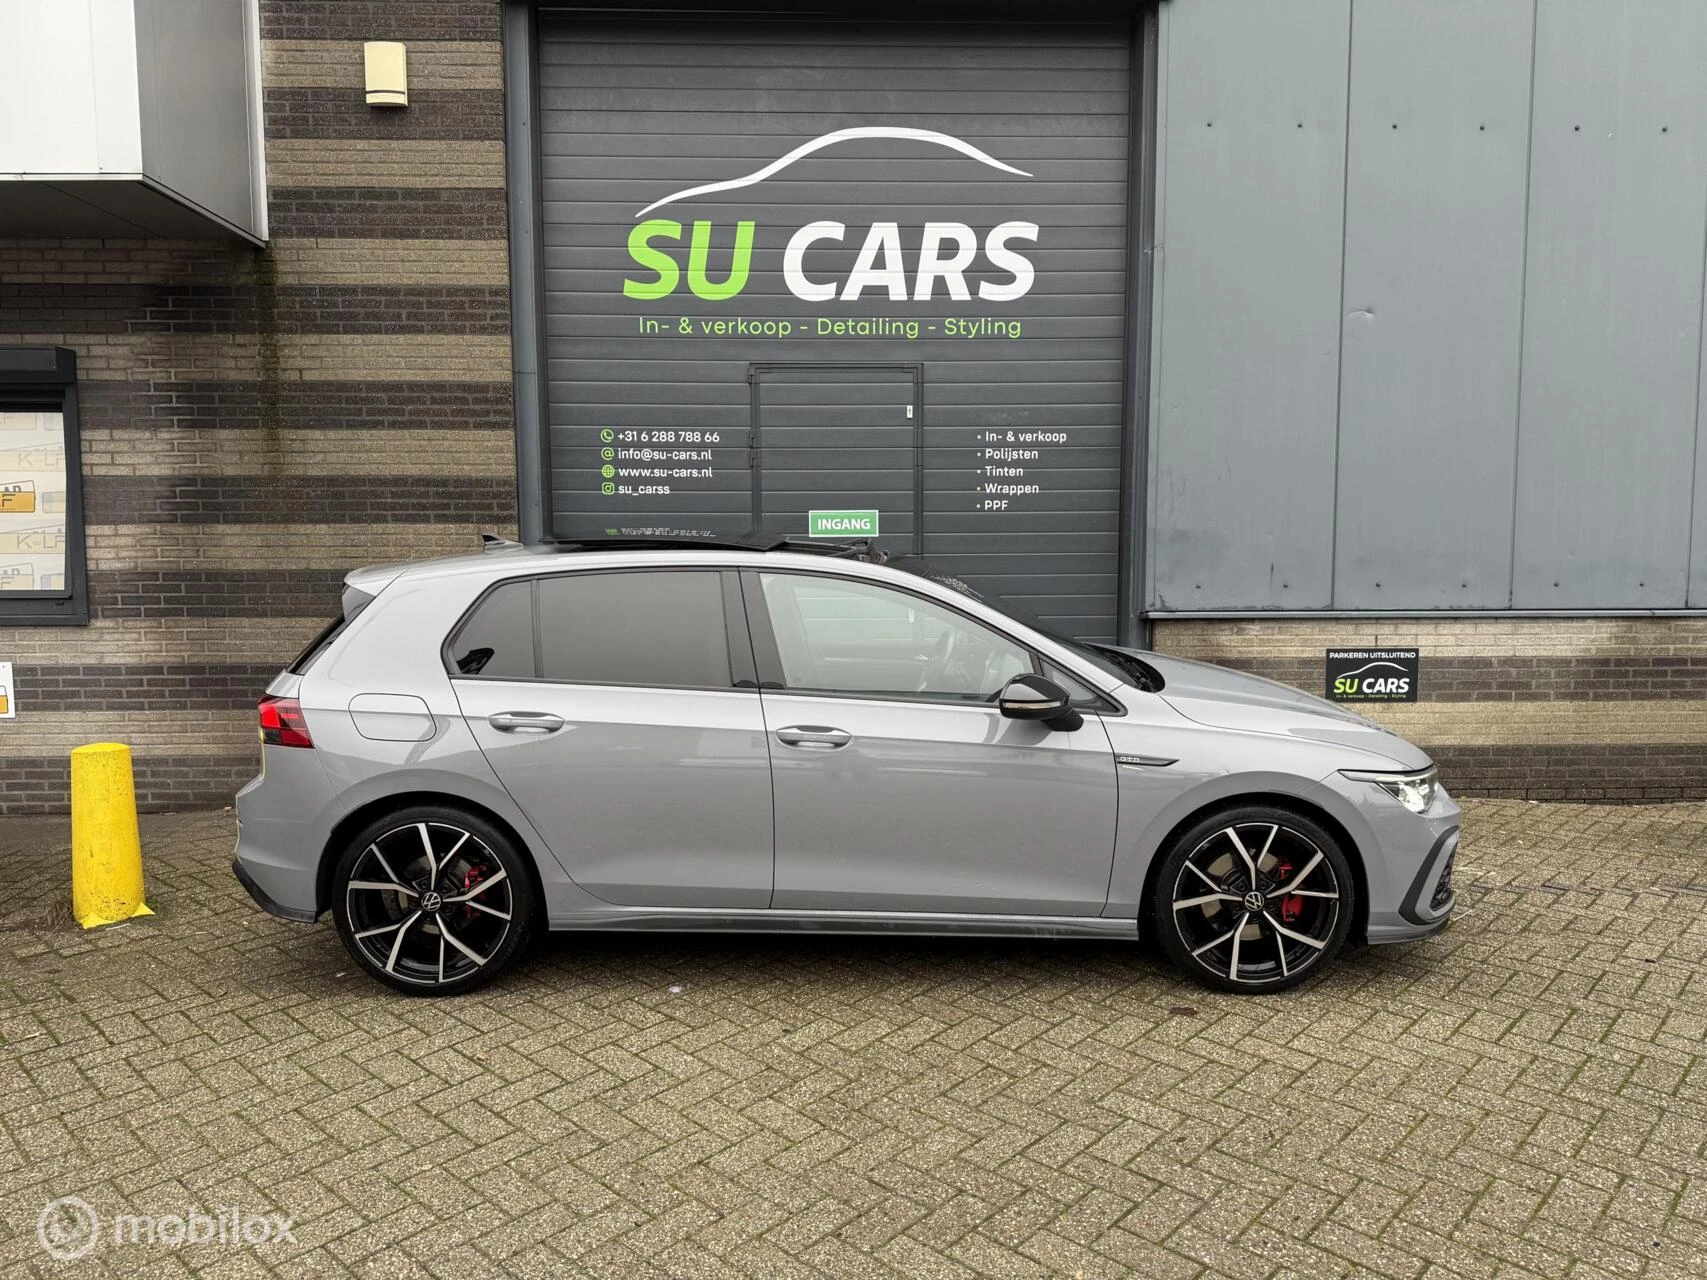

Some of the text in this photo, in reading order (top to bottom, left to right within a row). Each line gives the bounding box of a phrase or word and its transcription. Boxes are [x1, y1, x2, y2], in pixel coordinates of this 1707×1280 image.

[623, 219, 1039, 302] SU CARS
[639, 317, 670, 335] In-
[679, 318, 693, 335] &
[702, 317, 791, 338] verkoop
[817, 318, 919, 338] Detailing
[944, 318, 1021, 339] Styling
[617, 431, 720, 443] +31 6 288 788 66
[985, 431, 1067, 444] In- & verkoop
[618, 448, 712, 461] info@su-cars.nl
[985, 448, 1038, 461] Polijsten
[618, 466, 713, 477] www.su-cars.nl
[985, 466, 1024, 477] Tinten
[618, 485, 670, 496] su_carss
[984, 483, 1039, 496] Wrappen
[984, 500, 1009, 511] PPF
[817, 518, 871, 530] INGANG
[1333, 678, 1410, 693] SU CARS
